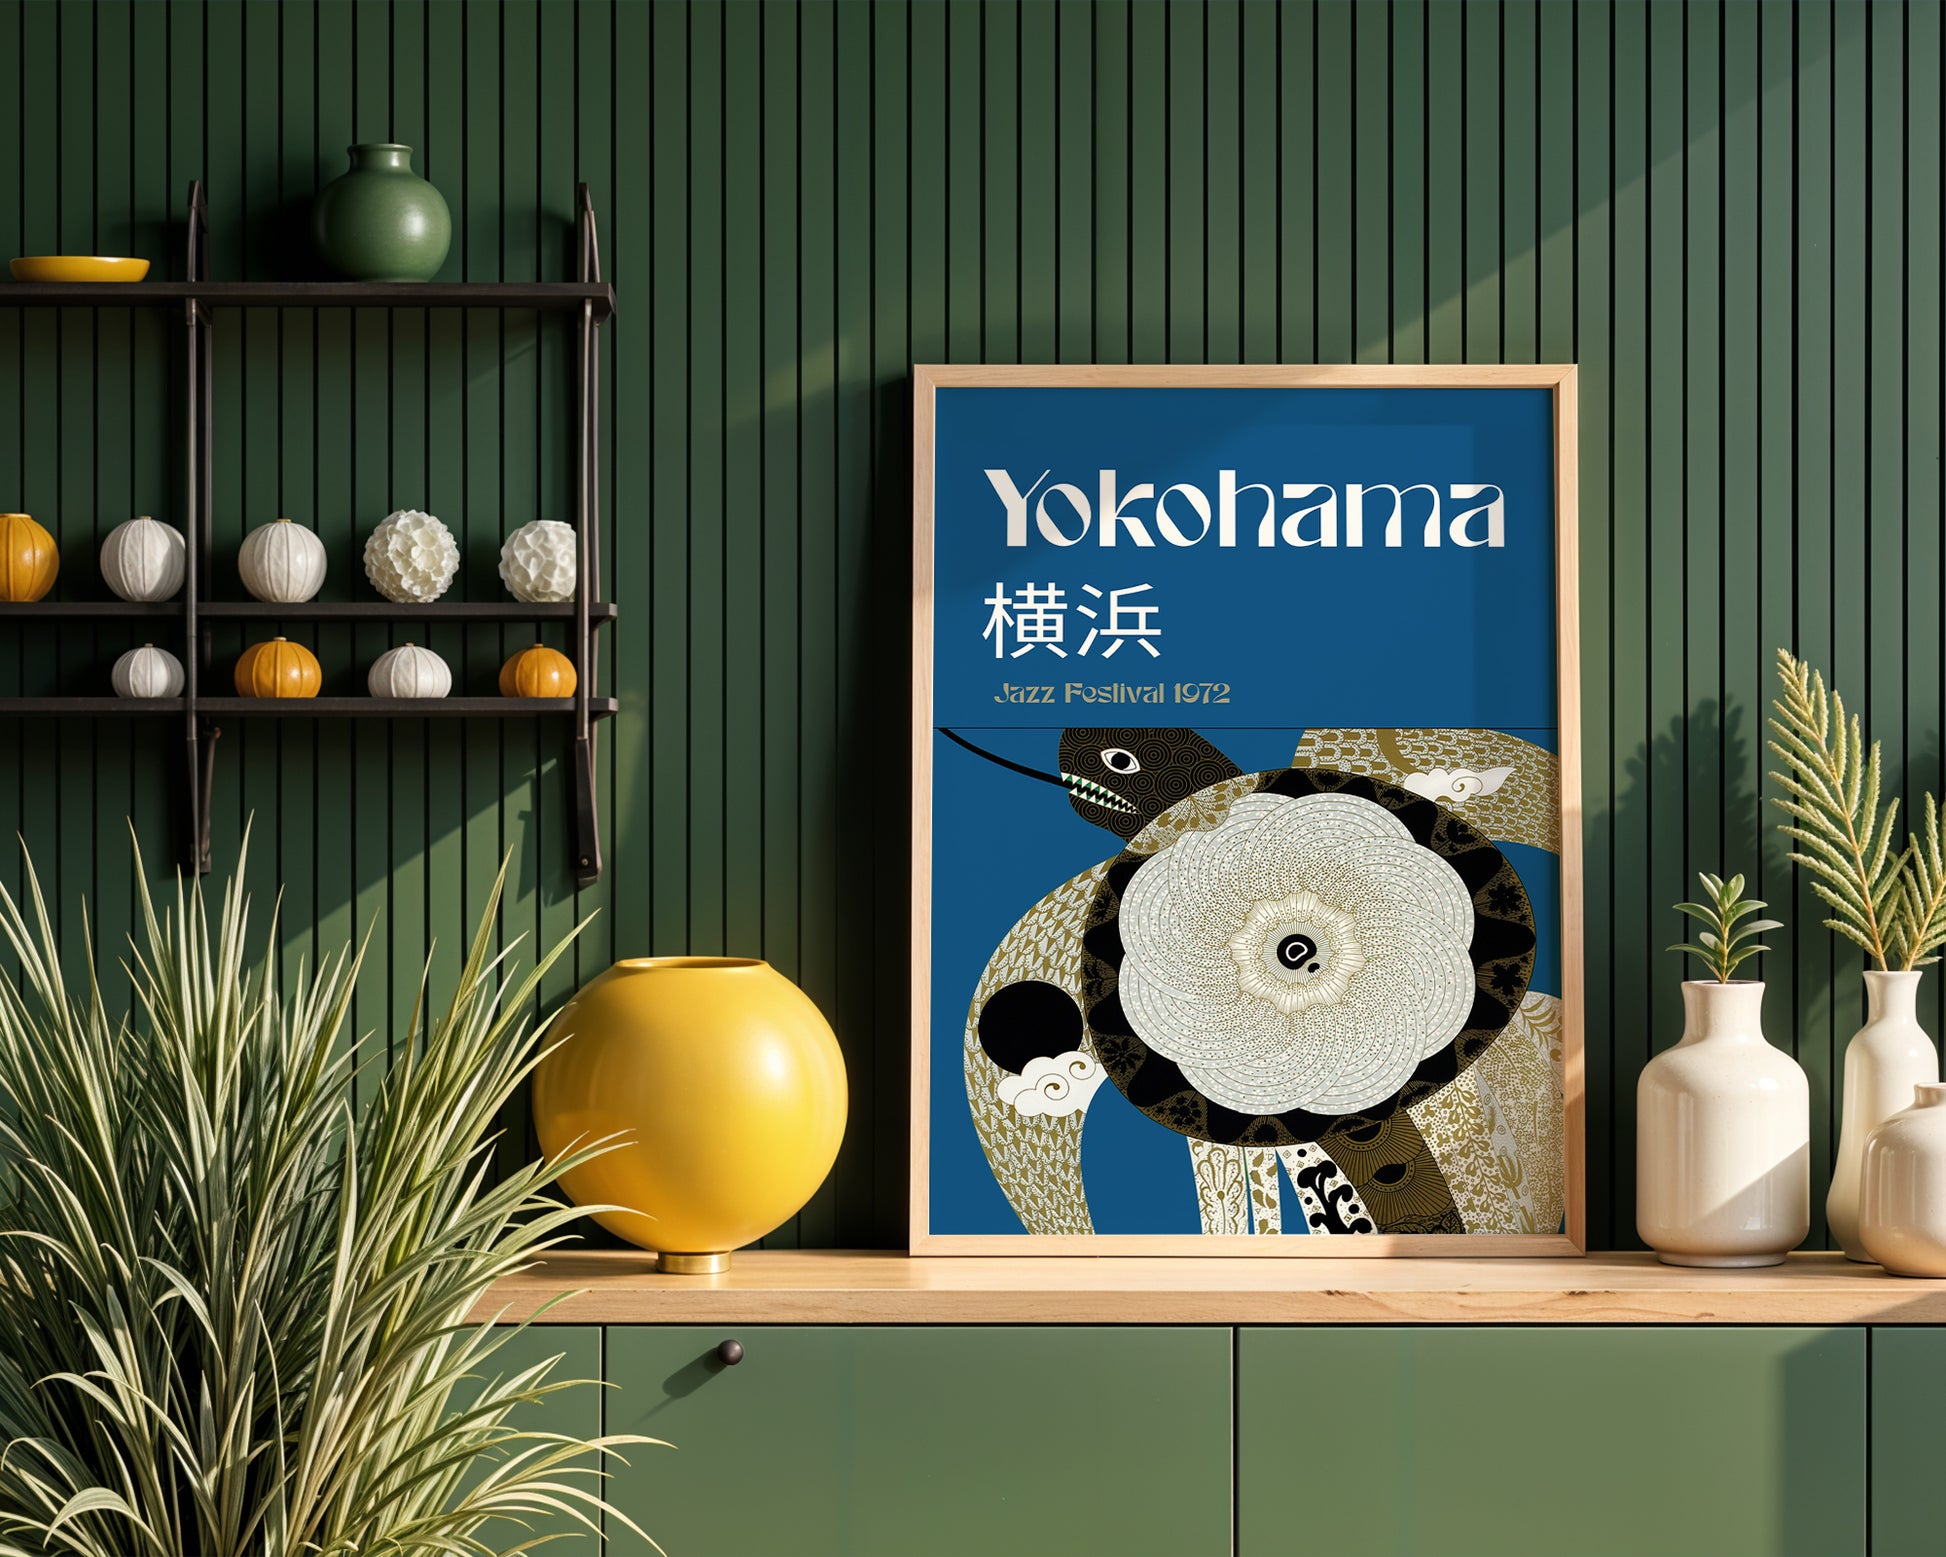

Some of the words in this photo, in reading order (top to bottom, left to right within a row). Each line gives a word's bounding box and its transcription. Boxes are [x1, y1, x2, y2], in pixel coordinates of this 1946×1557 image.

[983, 469, 1505, 548] Yokohama
[982, 581, 1162, 659] 横浜
[993, 682, 1056, 704] Jazz
[1064, 682, 1165, 704] Festival
[1173, 682, 1231, 705] 1972
